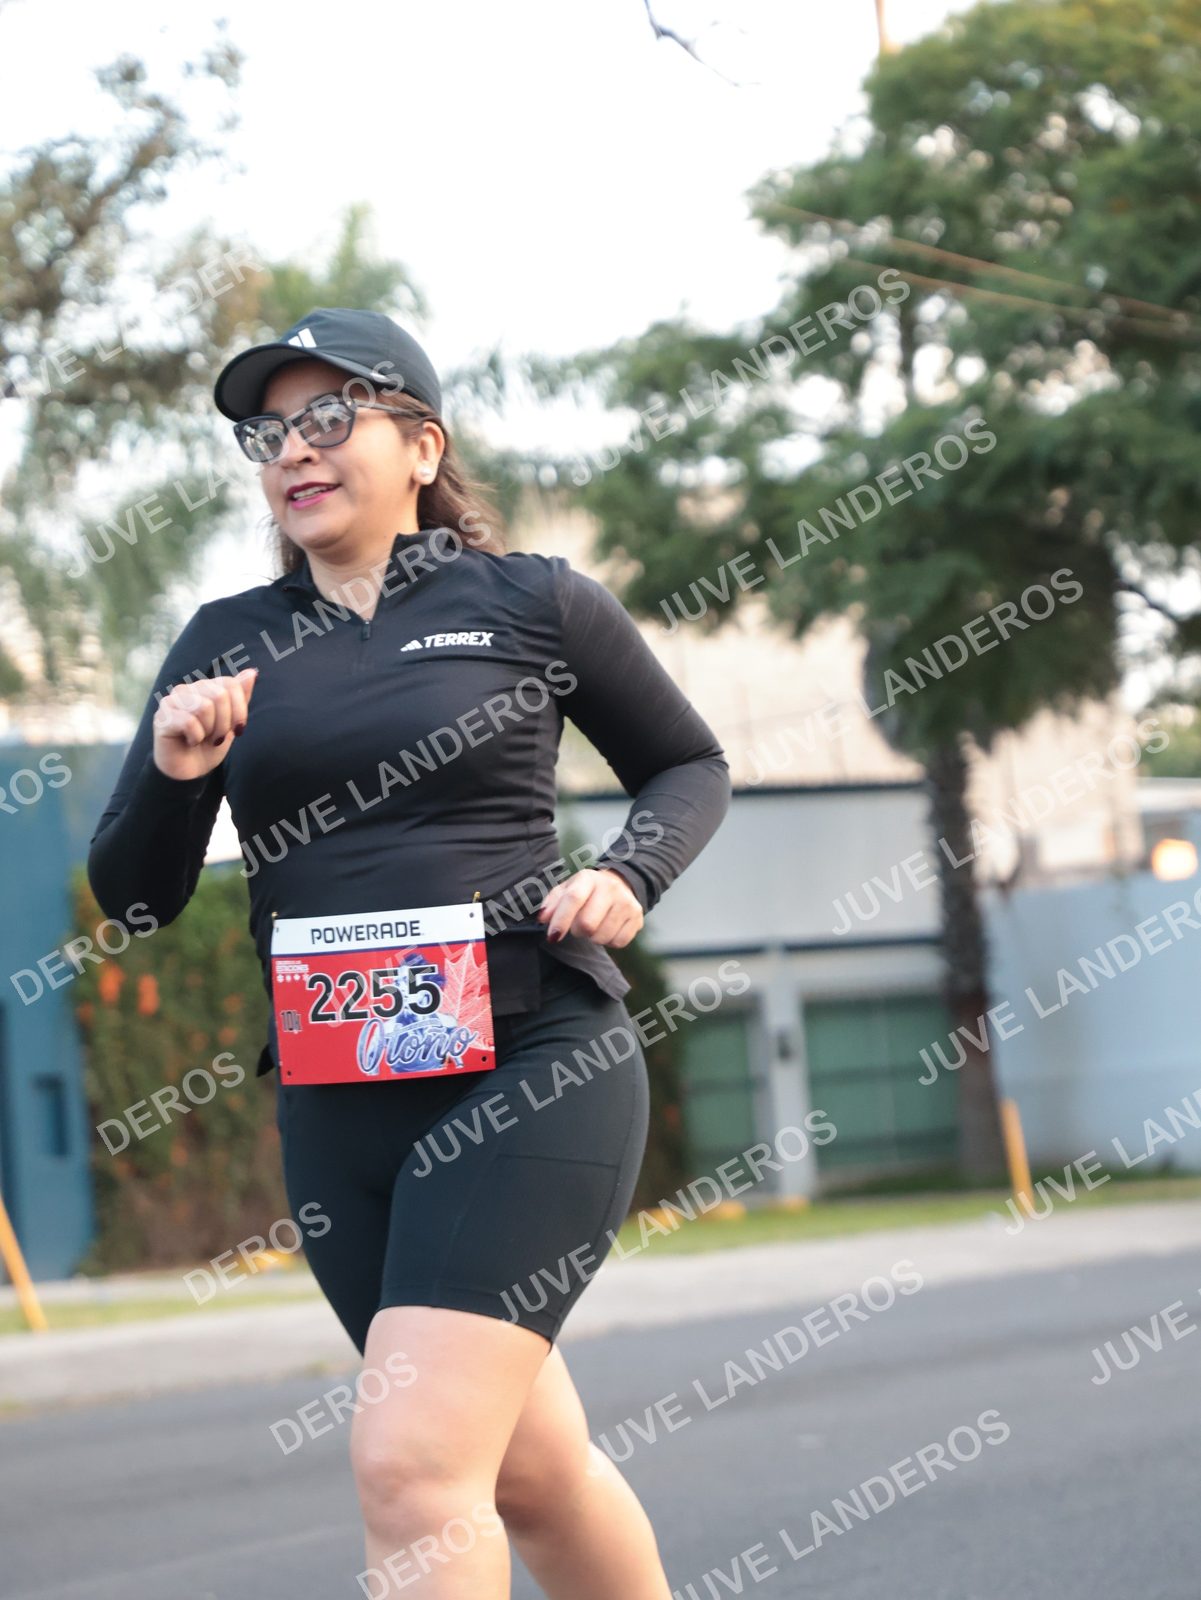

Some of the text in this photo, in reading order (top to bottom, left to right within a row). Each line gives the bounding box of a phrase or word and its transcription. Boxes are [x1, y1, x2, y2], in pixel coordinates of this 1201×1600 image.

[423, 631, 494, 648] TERREX
[310, 919, 421, 944] POWERADE
[306, 964, 442, 1024] 2255
[356, 1017, 479, 1074] Otoño
